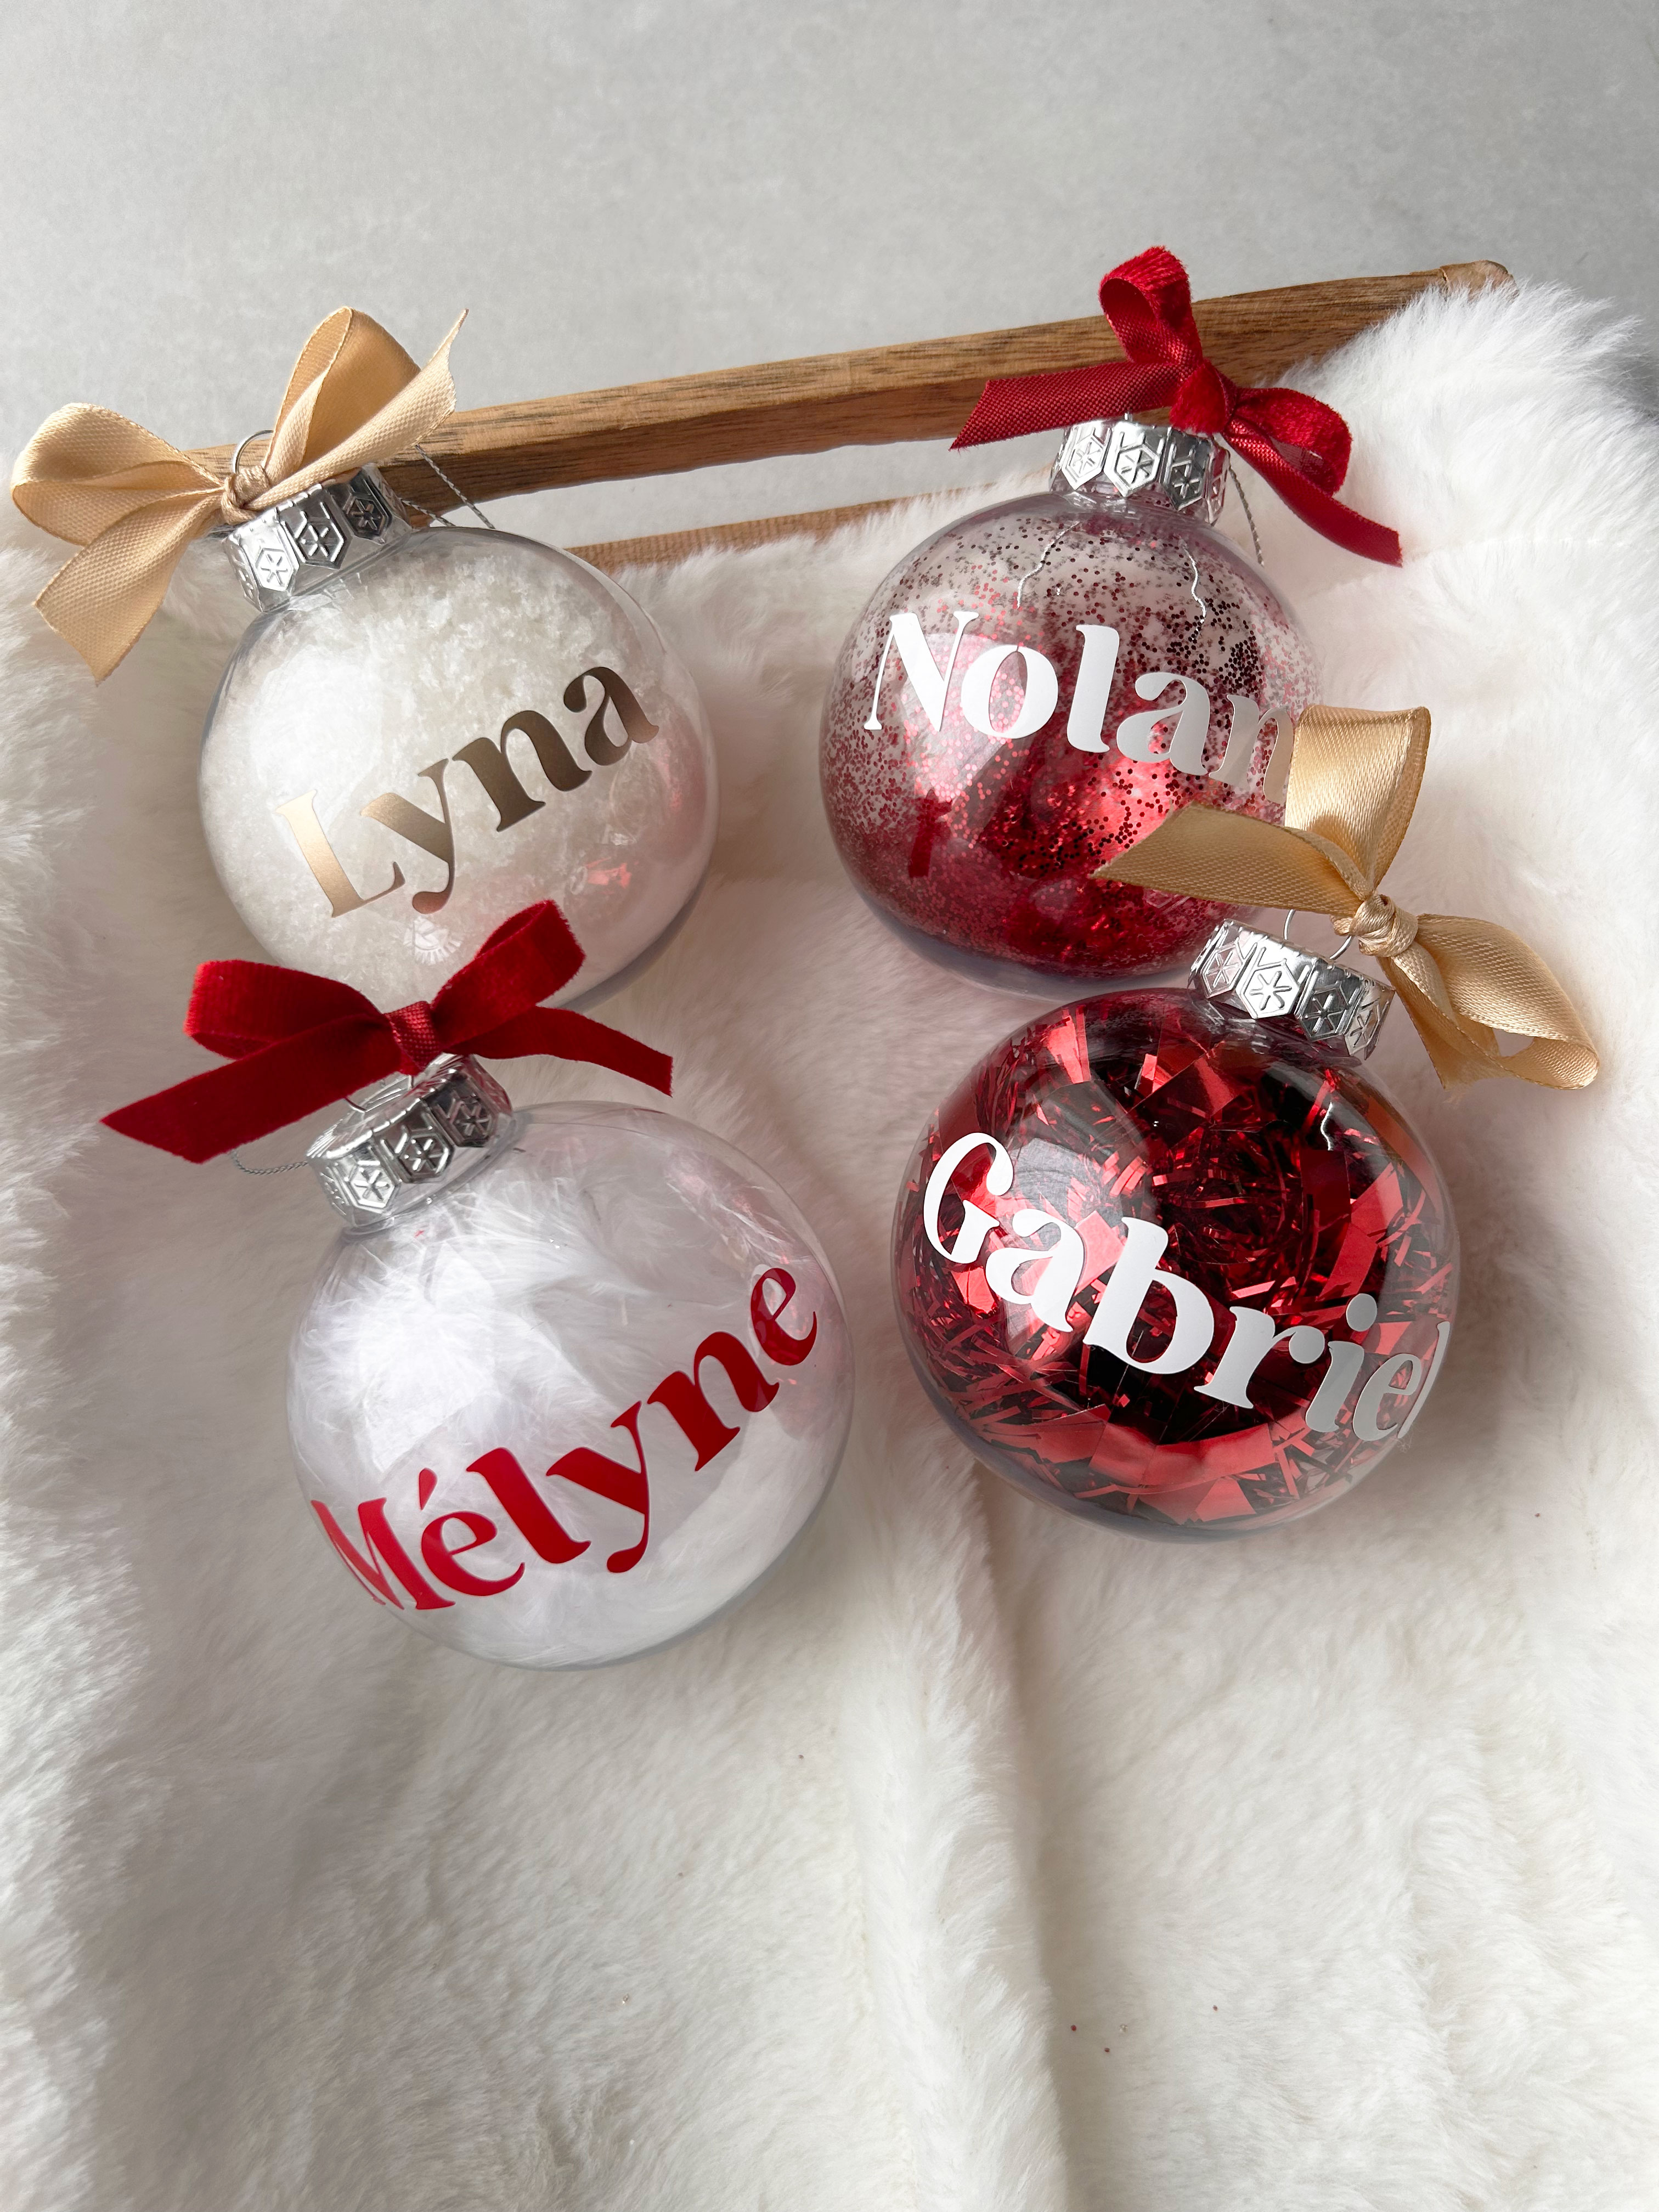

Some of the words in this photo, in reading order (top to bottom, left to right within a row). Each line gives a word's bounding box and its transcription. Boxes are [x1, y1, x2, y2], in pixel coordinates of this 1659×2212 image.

[276, 667, 660, 918] Lyna
[864, 611, 1295, 804] Nolan
[311, 1268, 817, 1610] Mélyne
